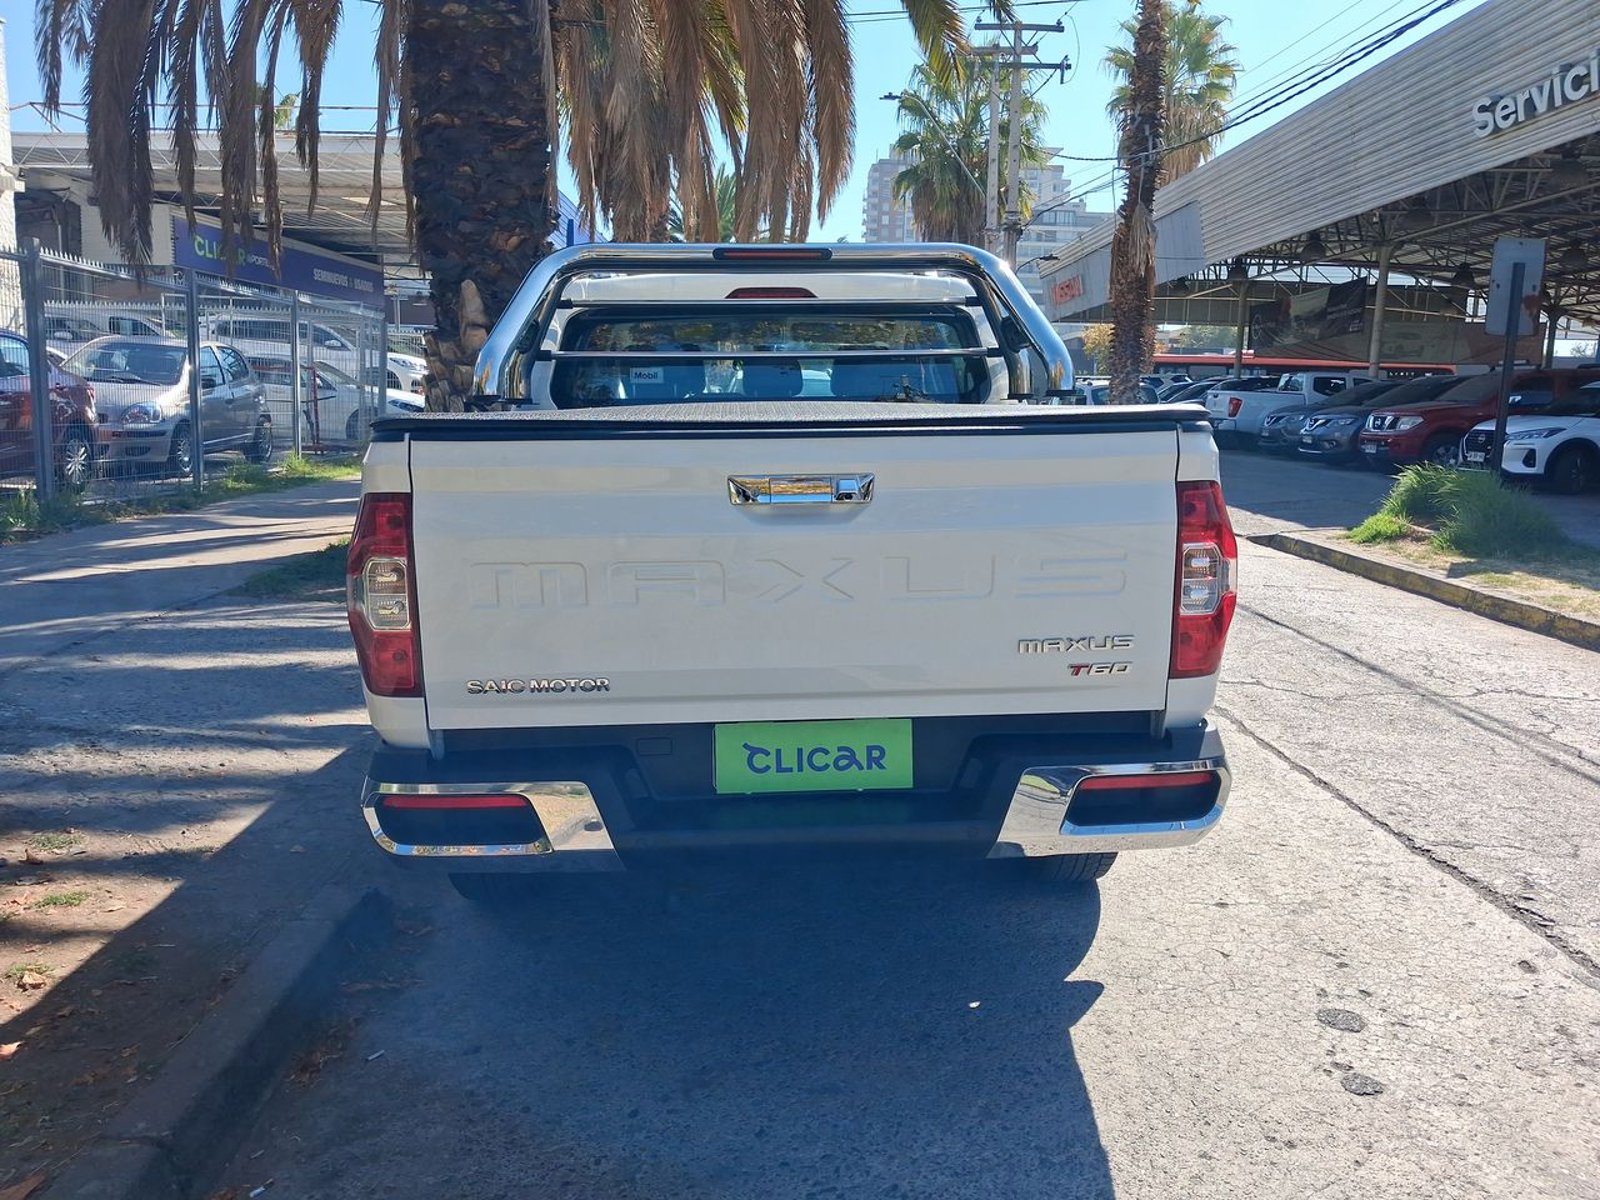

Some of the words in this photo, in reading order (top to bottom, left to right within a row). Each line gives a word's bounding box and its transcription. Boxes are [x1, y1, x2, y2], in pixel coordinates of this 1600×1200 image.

[634, 371, 658, 380] Mobil
[470, 555, 1129, 608] MAXUS
[1018, 634, 1135, 653] MAXUS
[1067, 661, 1133, 677] T60
[466, 679, 525, 695] SAIC
[529, 677, 611, 693] MOTOR
